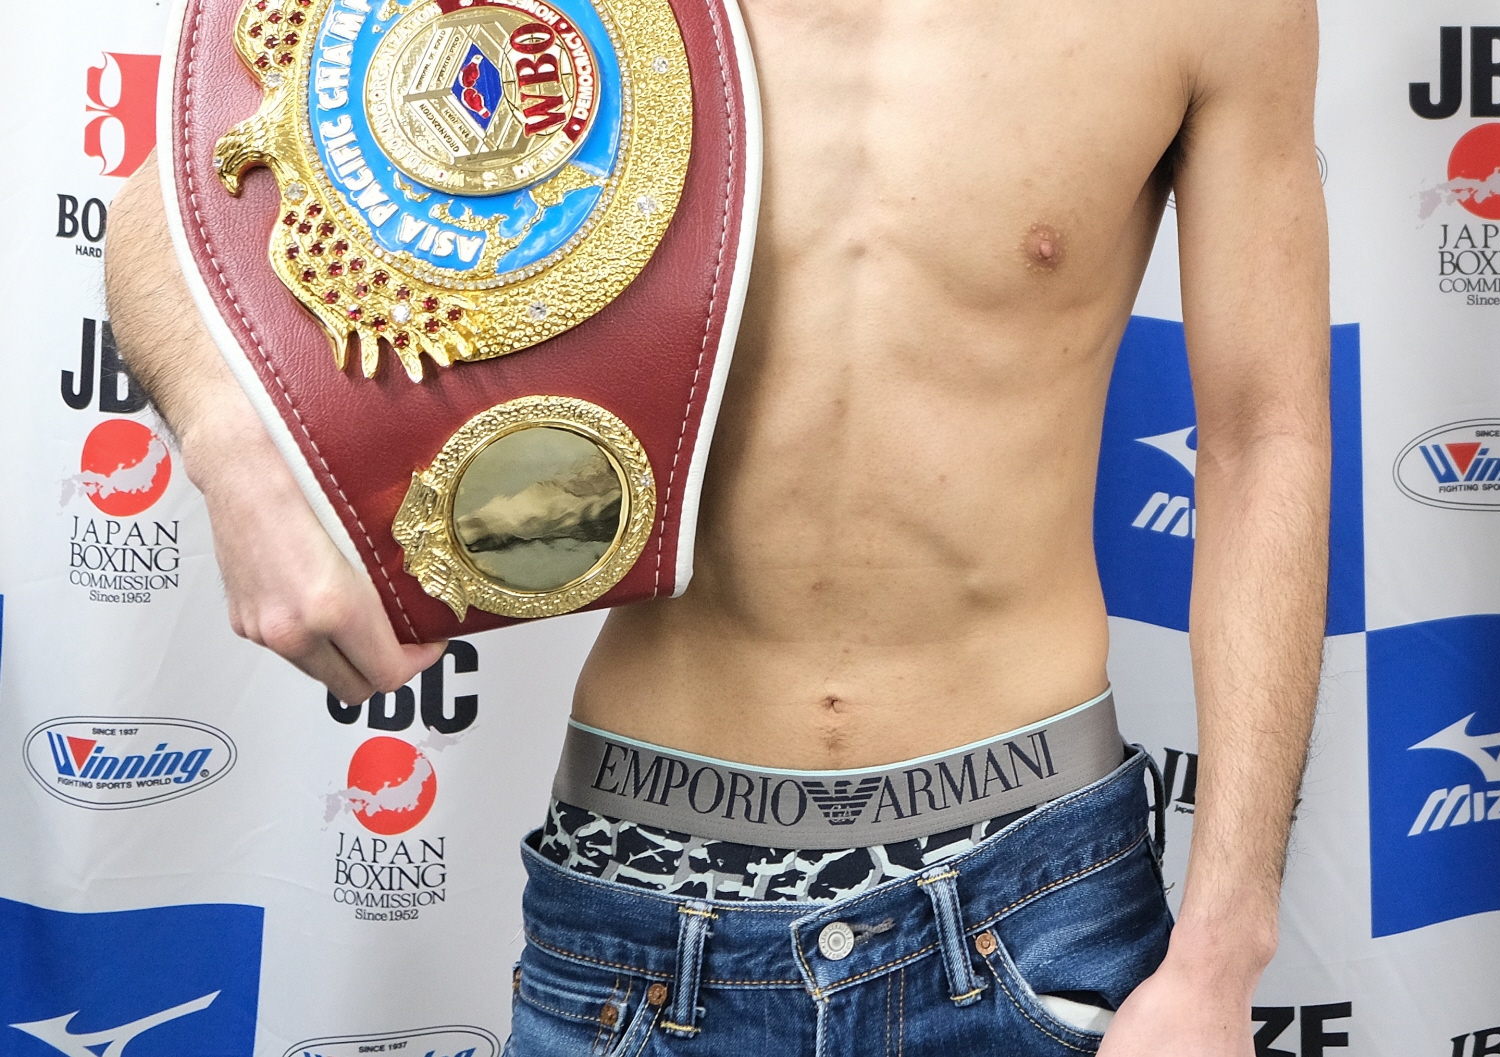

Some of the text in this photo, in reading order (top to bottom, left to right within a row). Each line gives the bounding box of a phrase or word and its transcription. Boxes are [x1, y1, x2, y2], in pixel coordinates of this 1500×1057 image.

[511, 23, 567, 137] WBO
[561, 26, 596, 120] DEMOCRACY
[326, 116, 399, 227] PACIFIC
[399, 213, 484, 264] ASIA
[75, 245, 102, 258] HARD
[1466, 294, 1500, 306] Since
[1439, 484, 1478, 493] FIGHTING
[71, 516, 180, 546] JAPAN
[70, 543, 180, 573] BOXING
[70, 571, 179, 591] COMMISSION
[89, 590, 151, 603] Since 1952
[119, 728, 139, 736] 1937
[46, 730, 213, 784] Winning
[57, 776, 93, 789] FIGHTING
[136, 778, 171, 787] WORLD
[591, 740, 808, 827] EMPORIO
[873, 729, 1059, 824] ARMANI
[336, 832, 446, 866] JAPAN
[334, 859, 447, 892] BOXING
[333, 888, 446, 908] COMMISSION
[355, 909, 419, 921] Since 1952
[358, 1044, 385, 1053] SINCE
[387, 1041, 408, 1050] 1937
